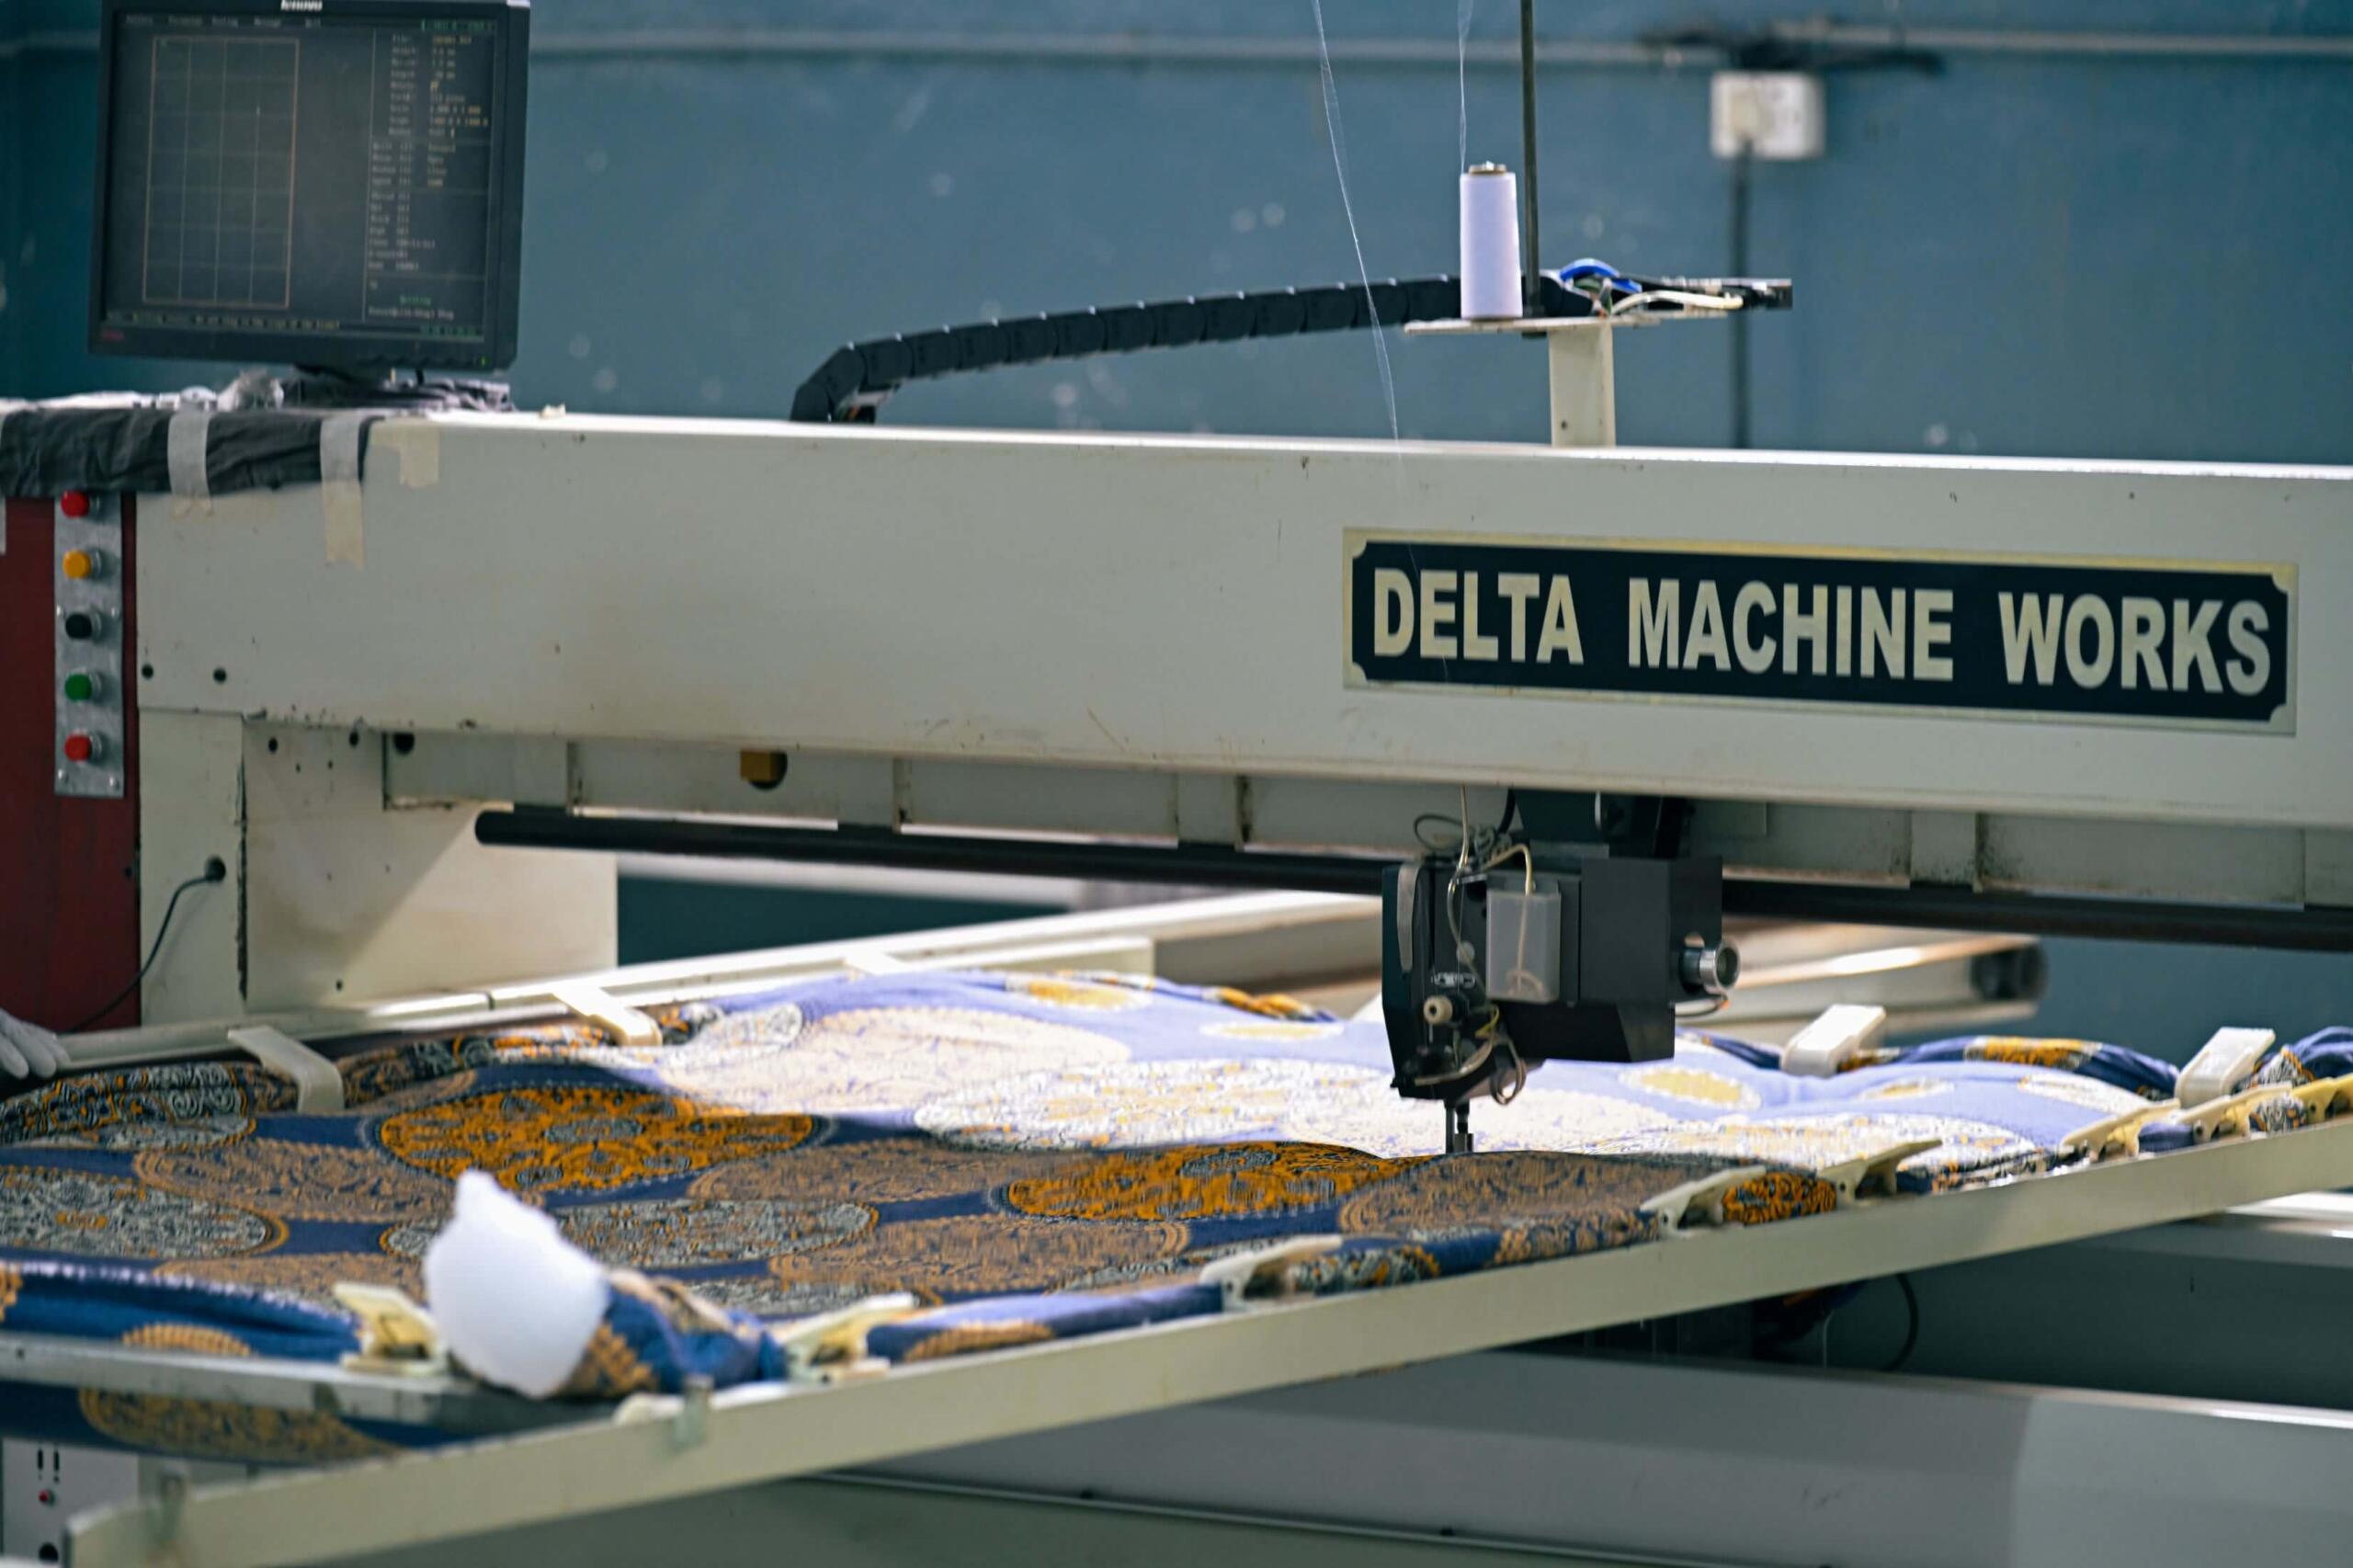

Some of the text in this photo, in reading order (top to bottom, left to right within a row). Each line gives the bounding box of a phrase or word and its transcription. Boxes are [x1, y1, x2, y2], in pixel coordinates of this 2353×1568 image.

[1373, 568, 2270, 696] DELTA MACHINE WORKS
